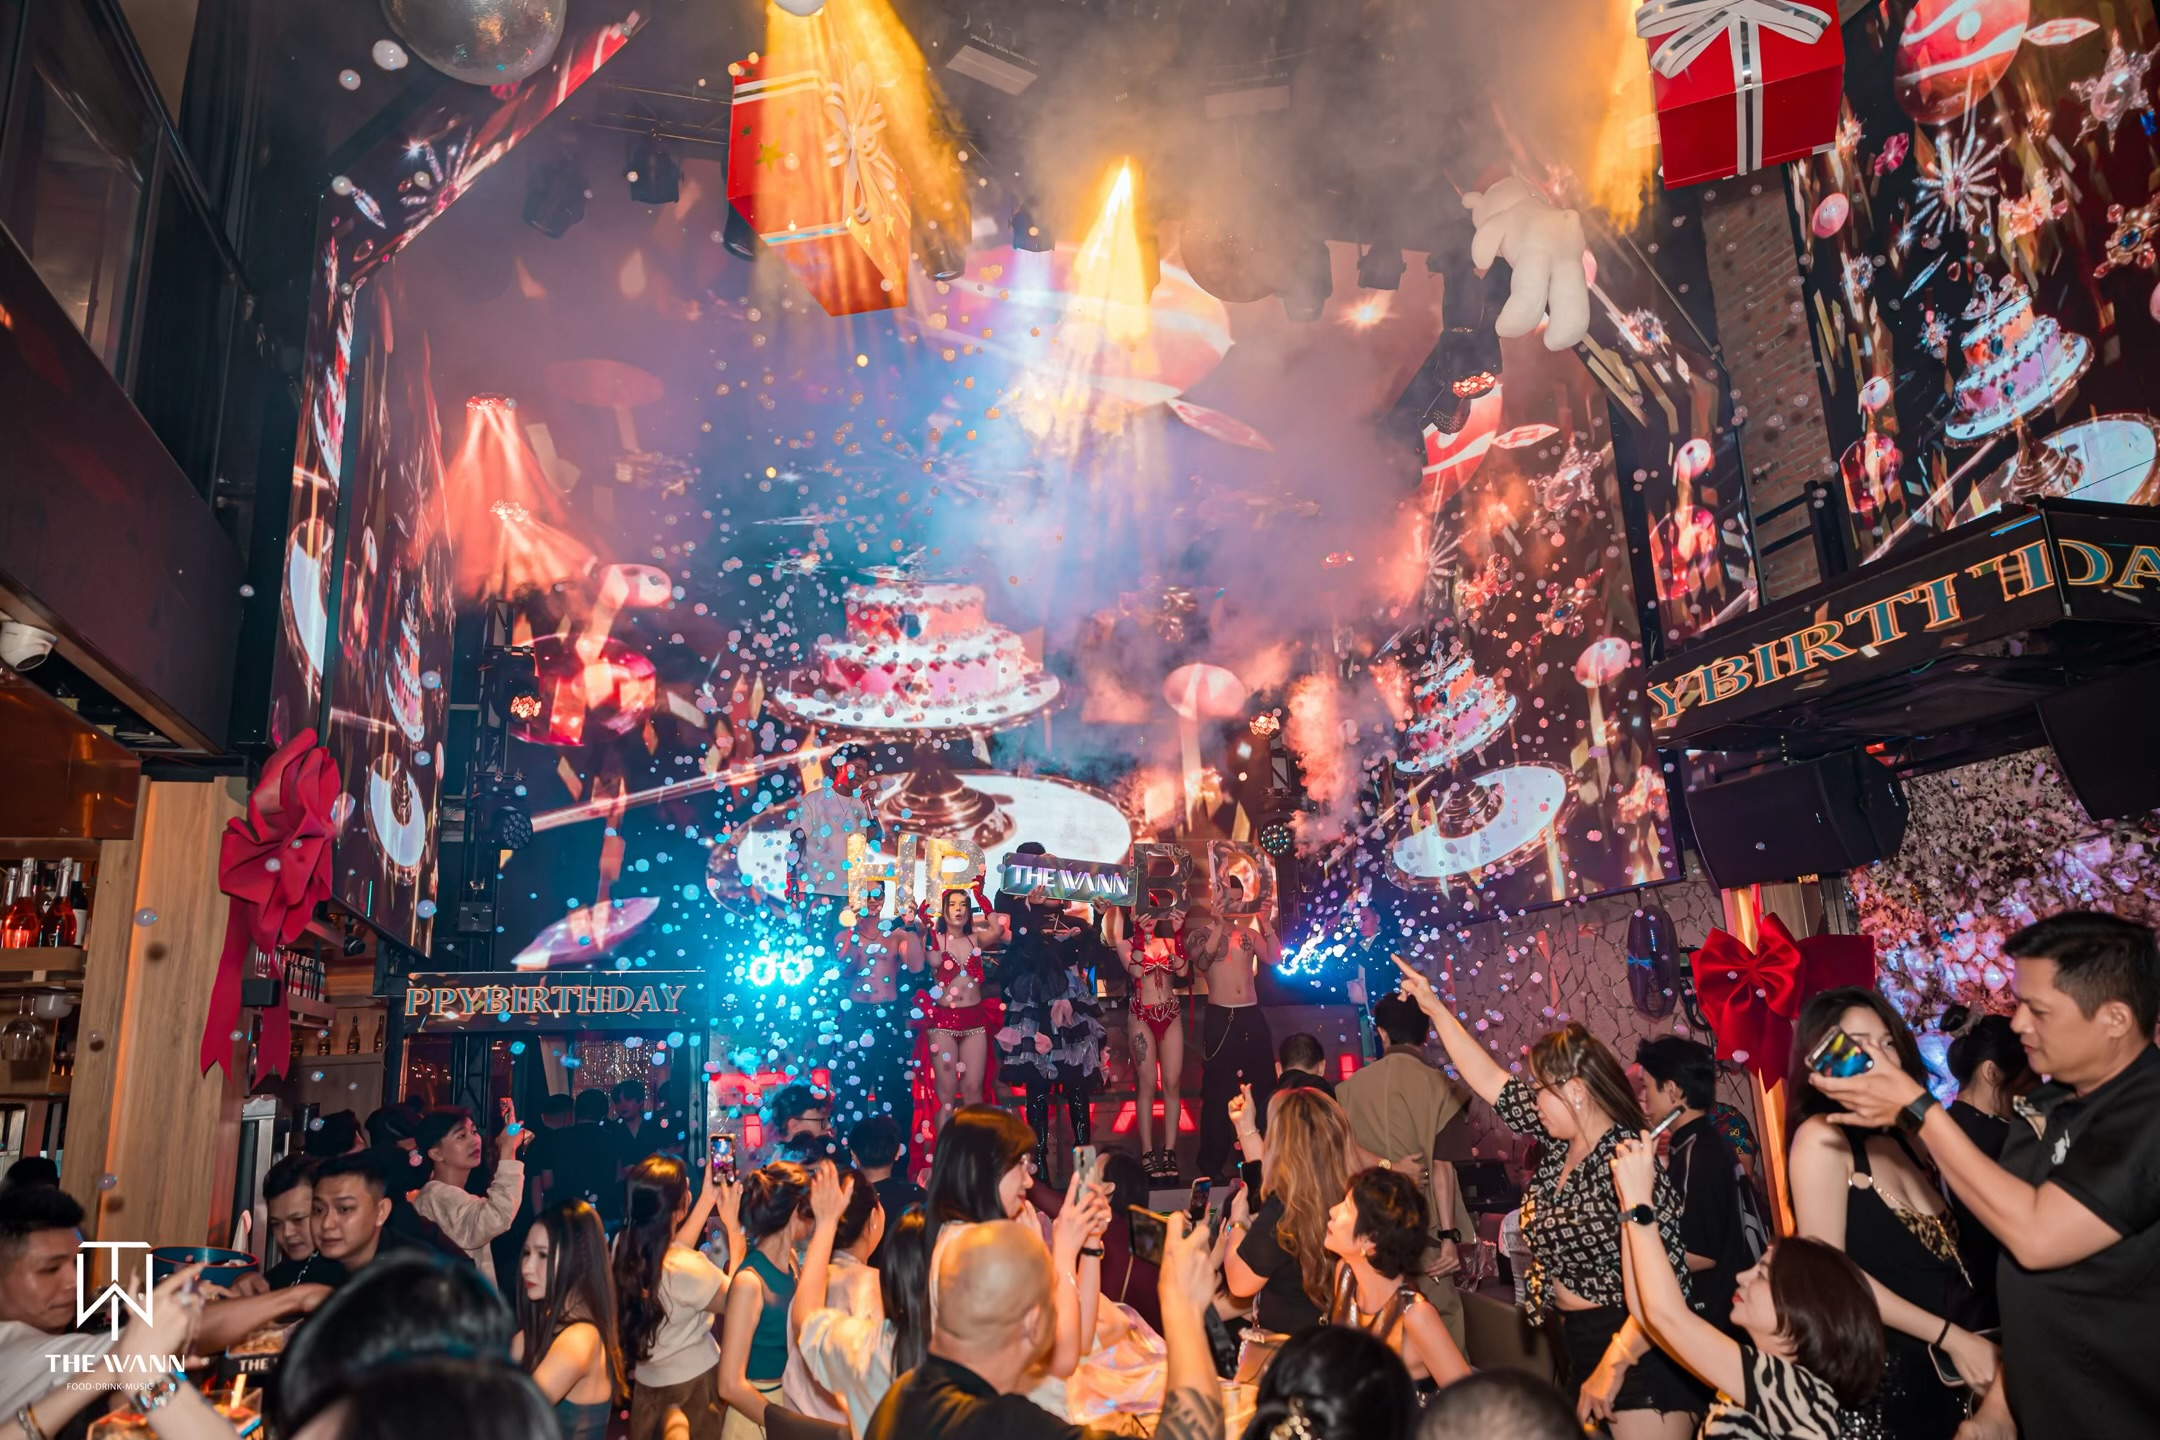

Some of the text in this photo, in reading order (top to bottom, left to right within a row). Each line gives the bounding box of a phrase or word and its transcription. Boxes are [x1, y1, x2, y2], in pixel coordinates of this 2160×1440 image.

[1010, 864, 1129, 896] THE WANN
[404, 985, 687, 1016] PPYBIRTHDAY
[239, 1358, 270, 1372] THE
